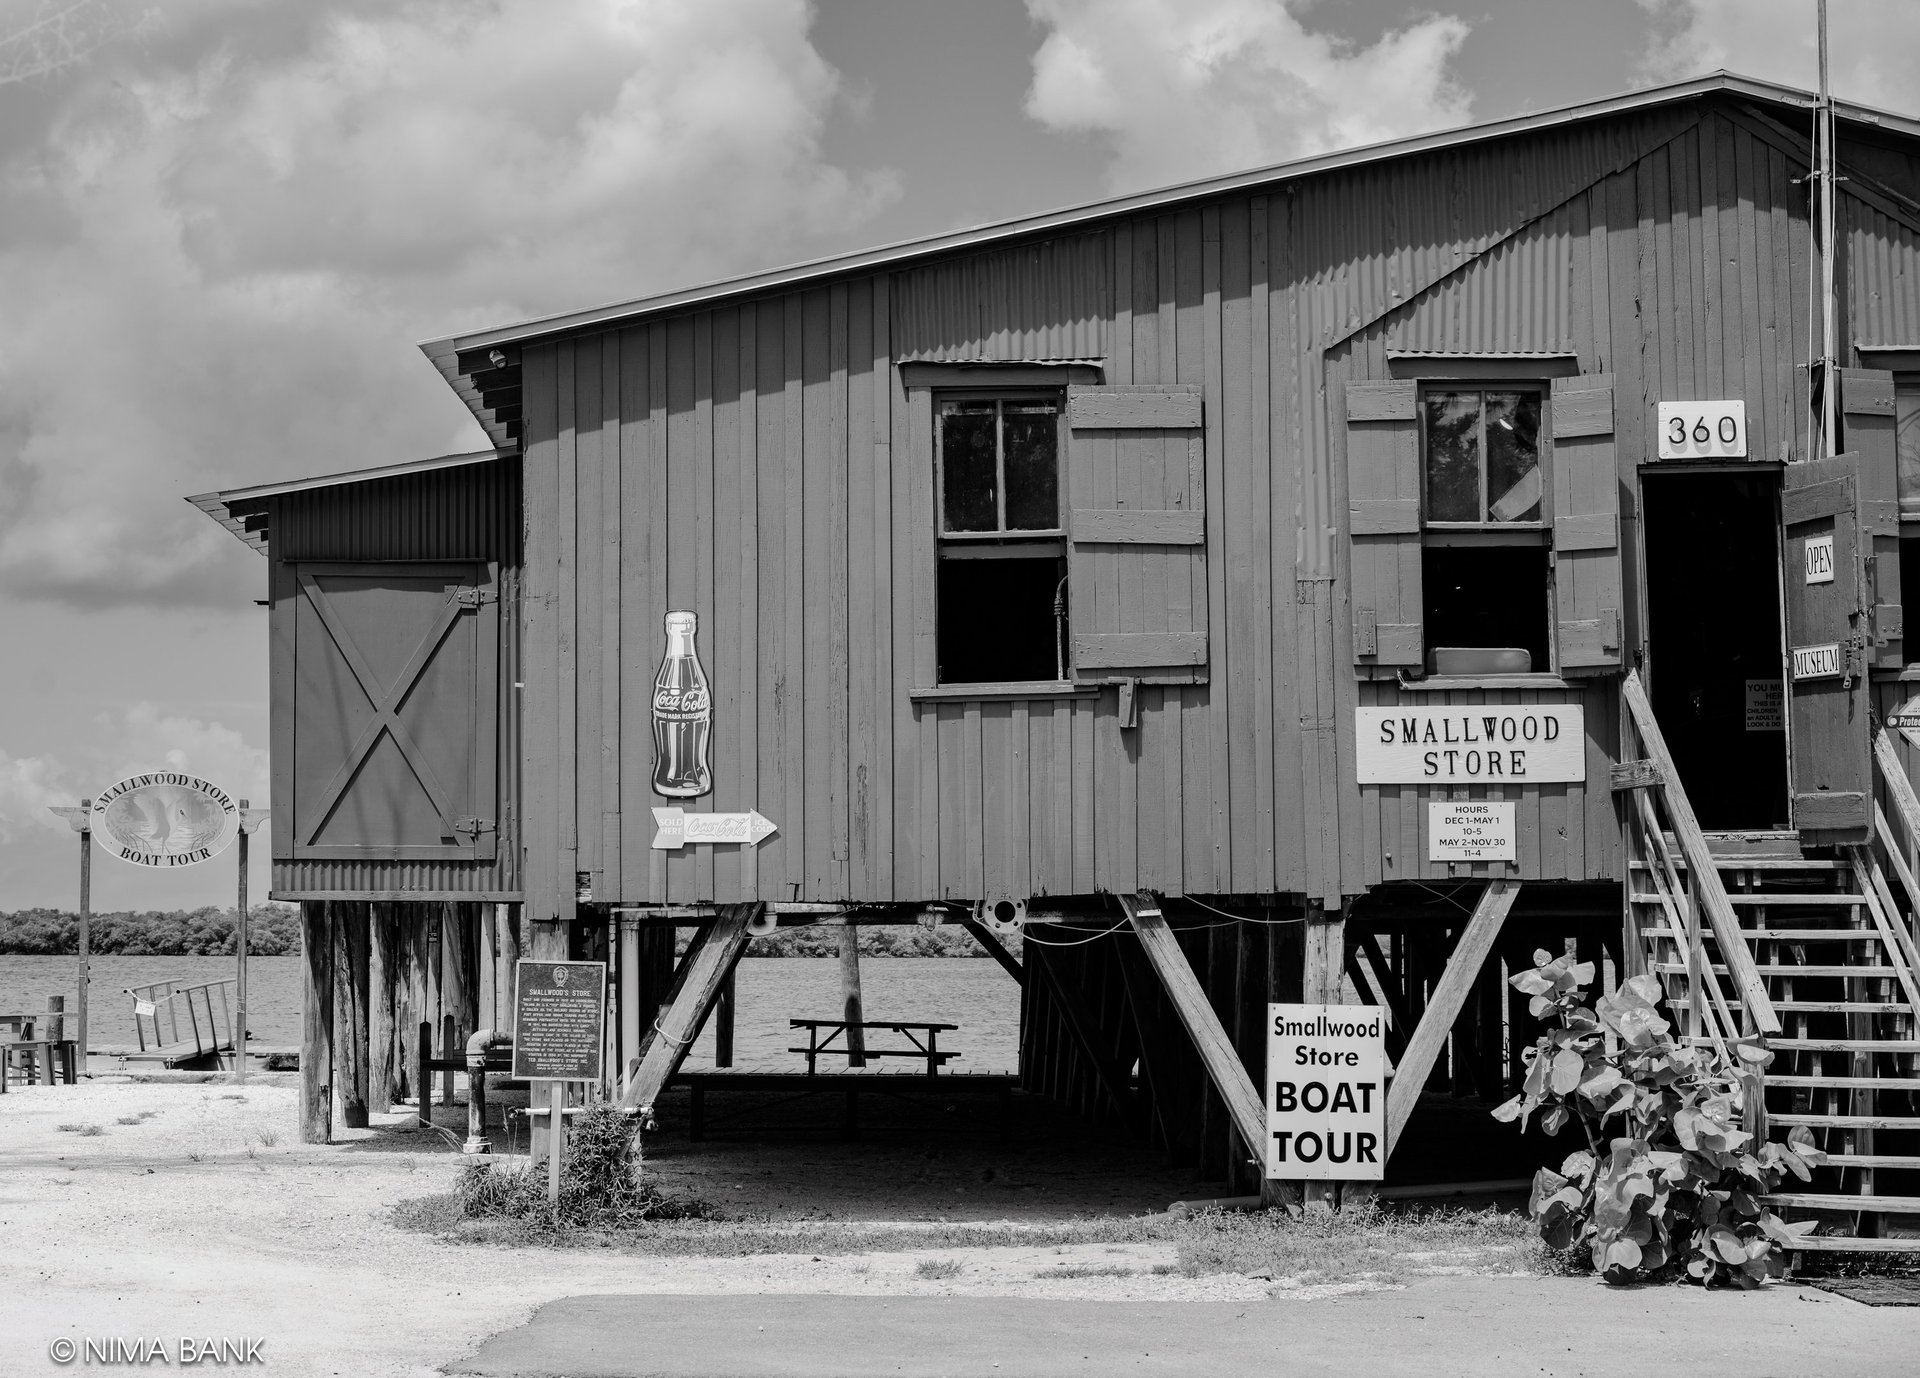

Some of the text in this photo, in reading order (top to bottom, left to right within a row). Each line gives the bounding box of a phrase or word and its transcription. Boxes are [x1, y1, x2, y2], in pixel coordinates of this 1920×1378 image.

[1668, 416, 1736, 444] 360
[1806, 544, 1832, 575] OPEN
[1795, 648, 1839, 676] MUSEUM
[1747, 683, 1784, 692] YOU MU
[1765, 692, 1783, 700] HER
[1380, 716, 1560, 744] SMALLWOOD
[1424, 750, 1526, 776] STORE
[94, 773, 236, 815] SMALLWOOD STORE
[1455, 806, 1489, 814] HOURS
[659, 818, 683, 826] SOLD
[661, 827, 683, 835] HERE
[120, 847, 212, 866] BOAT TOUR
[529, 988, 592, 997] SMALLWOOD'S STORE
[1274, 1016, 1380, 1038] Smallwood
[1295, 1045, 1359, 1066] Store
[1276, 1081, 1376, 1113] BOAT
[1273, 1131, 1378, 1163] TOUR
